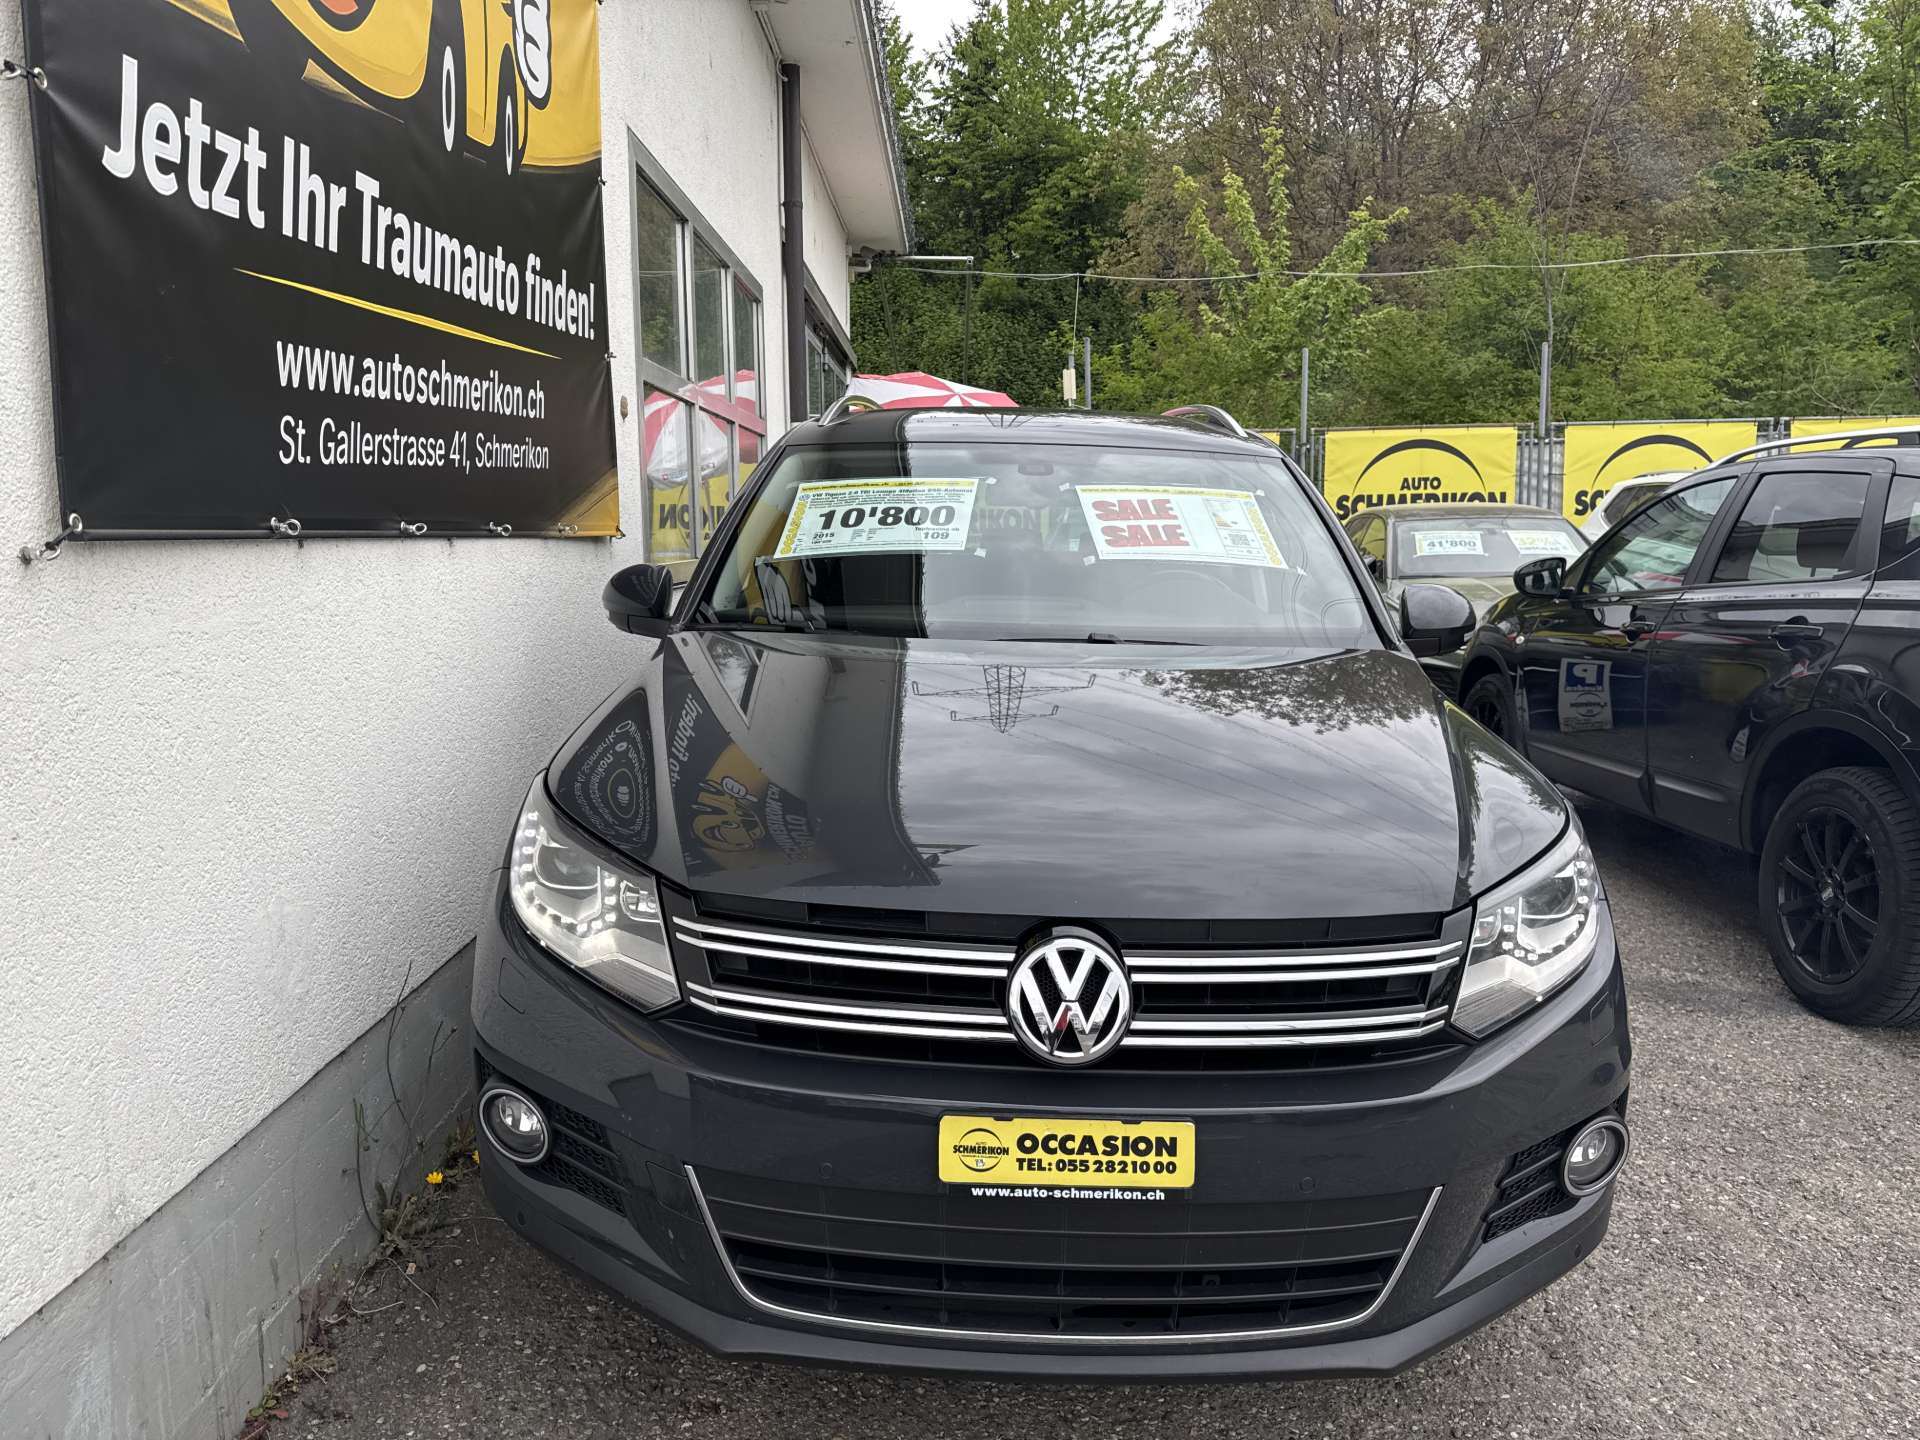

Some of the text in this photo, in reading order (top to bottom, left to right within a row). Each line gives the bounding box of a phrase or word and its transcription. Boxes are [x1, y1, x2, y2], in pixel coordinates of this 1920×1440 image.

[102, 54, 595, 340] Jetzt Ihr Traumauto finden!
[276, 340, 545, 419] www.autoschmerikon.ch
[279, 415, 549, 475] St. Gallerstrasse 41, Schmerikon
[1400, 476, 1442, 491] AUTO
[819, 505, 956, 530] 10'800
[1091, 498, 1179, 522] SALE
[922, 532, 950, 540] 109
[1100, 524, 1190, 548] SALE
[952, 1144, 1010, 1156] SCHMERIKON
[1016, 1132, 1178, 1157] OCCASION
[1016, 1157, 1052, 1171] TEL:
[971, 1187, 1166, 1200] www.auto-schmerikon.ch
